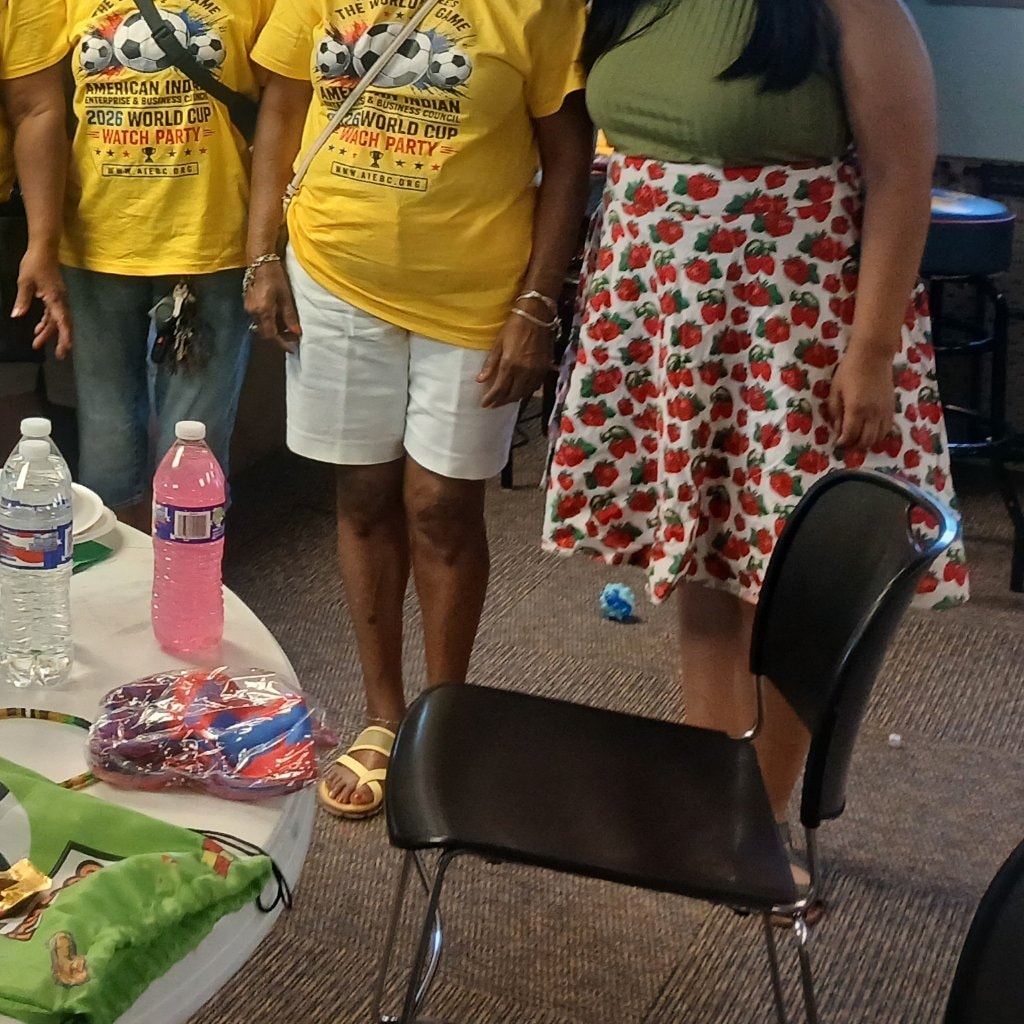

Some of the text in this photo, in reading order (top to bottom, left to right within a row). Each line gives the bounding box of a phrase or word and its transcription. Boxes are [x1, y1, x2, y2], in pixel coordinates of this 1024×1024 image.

[335, 2, 366, 20] THE
[435, 8, 471, 32] GAME
[86, 80, 203, 96] AMERICAN IND
[85, 96, 130, 105] ENTERPRISE
[133, 96, 138, 104] &
[141, 96, 182, 106] BUSINESS
[368, 96, 374, 104] &
[376, 99, 421, 116] BUSINESS
[422, 110, 460, 124] COUNCIL
[404, 96, 460, 114] INDIAN
[86, 106, 212, 127] 2026 WORLD CUP
[361, 110, 419, 136] WORLD
[424, 124, 458, 140] CUP
[102, 126, 201, 145] WATCH PARTY
[386, 136, 439, 156] PARTY
